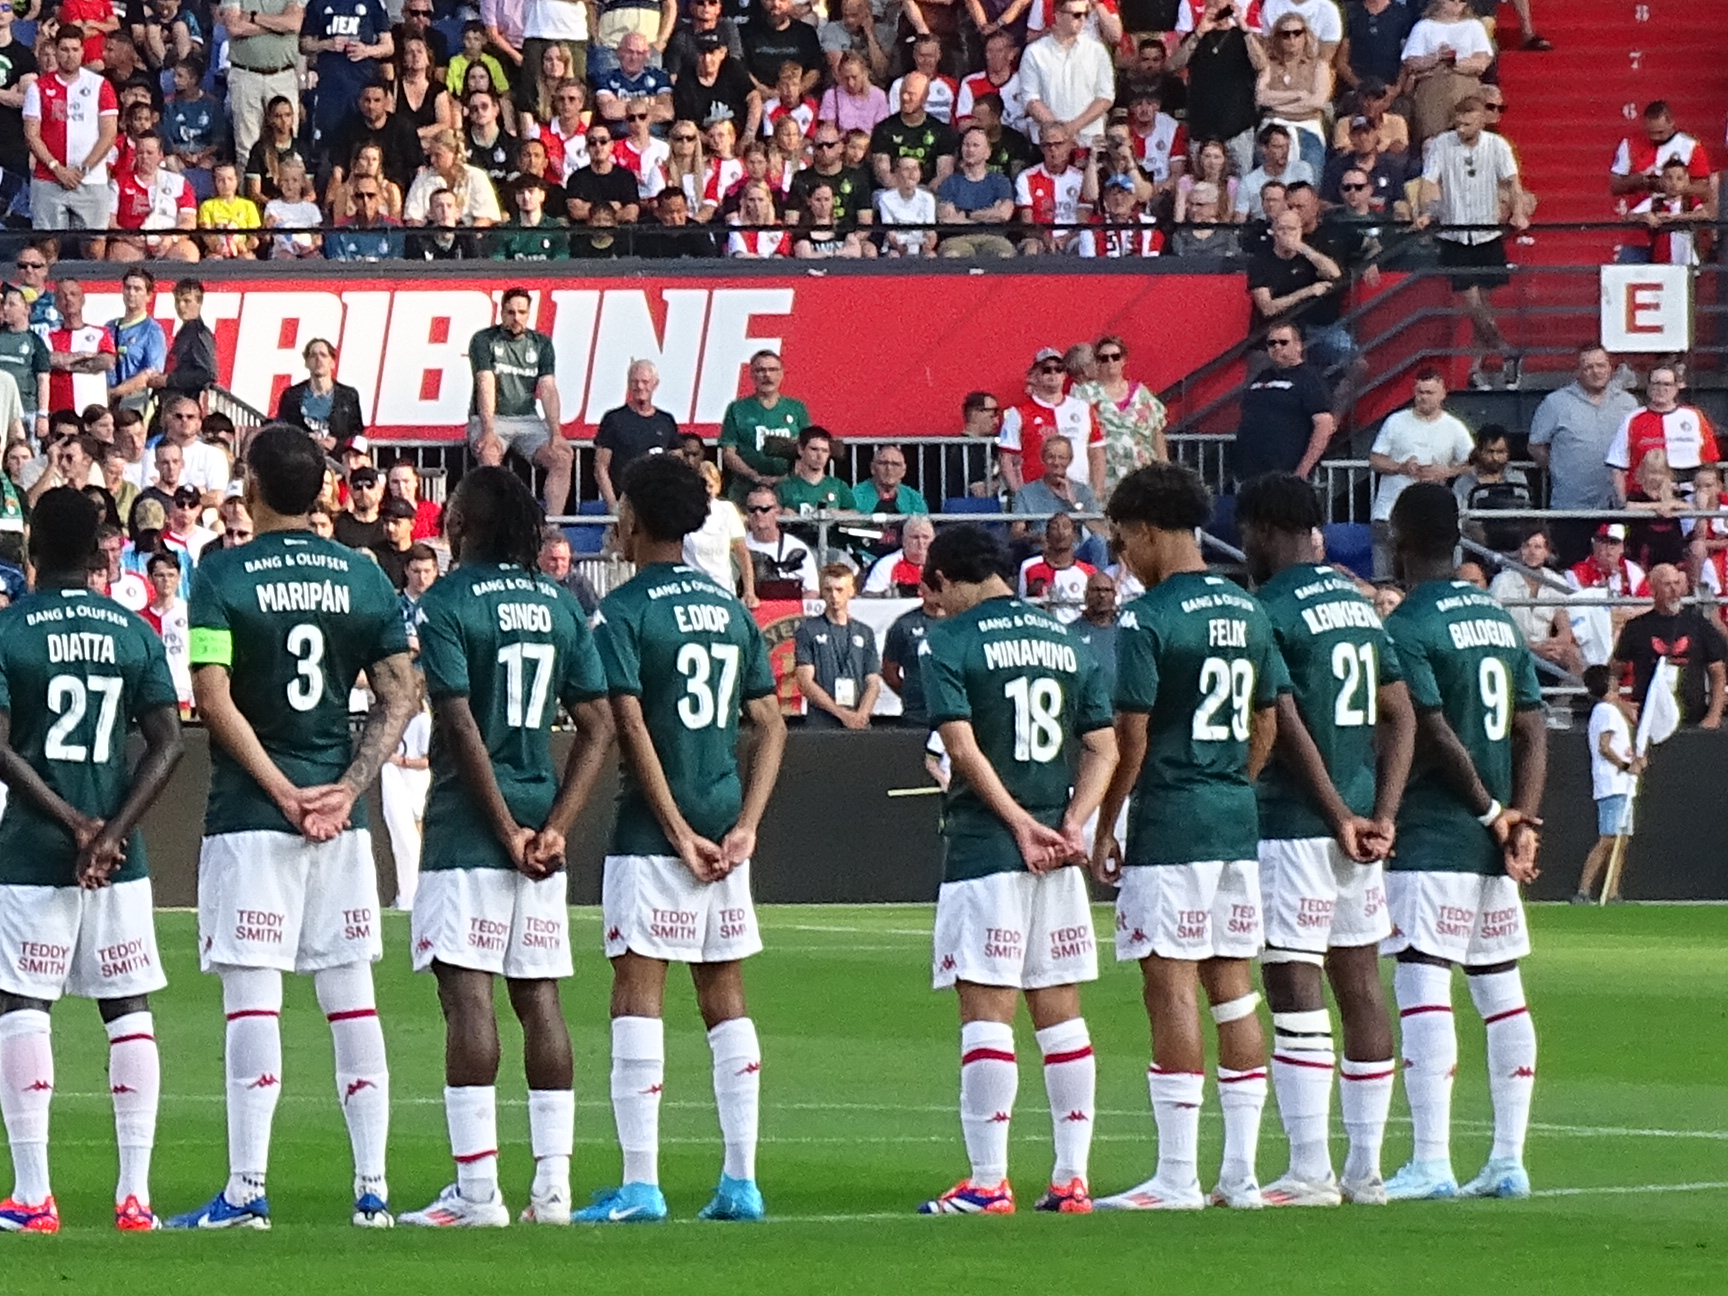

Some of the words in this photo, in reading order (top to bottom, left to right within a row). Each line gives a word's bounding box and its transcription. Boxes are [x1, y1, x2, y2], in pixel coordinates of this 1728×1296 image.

[1625, 282, 1664, 335] E
[244, 556, 282, 573] BANG
[256, 579, 350, 614] MARIPÁN
[26, 606, 63, 626] BANG
[497, 603, 552, 633] SINGO
[673, 604, 730, 633] E.DIOP
[47, 632, 115, 664] DIATTA
[1448, 619, 1517, 650] BALOGUN
[287, 623, 324, 712] 3
[983, 639, 1077, 674] MINAMINO
[497, 642, 555, 729] 17
[676, 642, 739, 730] 37
[1192, 657, 1254, 742] 29
[1331, 642, 1377, 727] 21
[1479, 657, 1509, 741] 9
[45, 674, 124, 763] 27
[1004, 676, 1063, 763] 18
[236, 909, 285, 927] TEDDY
[343, 908, 371, 924] TED
[651, 907, 698, 925] TEDDY
[719, 908, 745, 924] TED
[235, 925, 283, 944] SMITH
[986, 927, 1022, 944] TEDD
[1049, 925, 1088, 946] TEDD
[21, 941, 70, 959] TEDDY
[17, 958, 66, 975] SMITH
